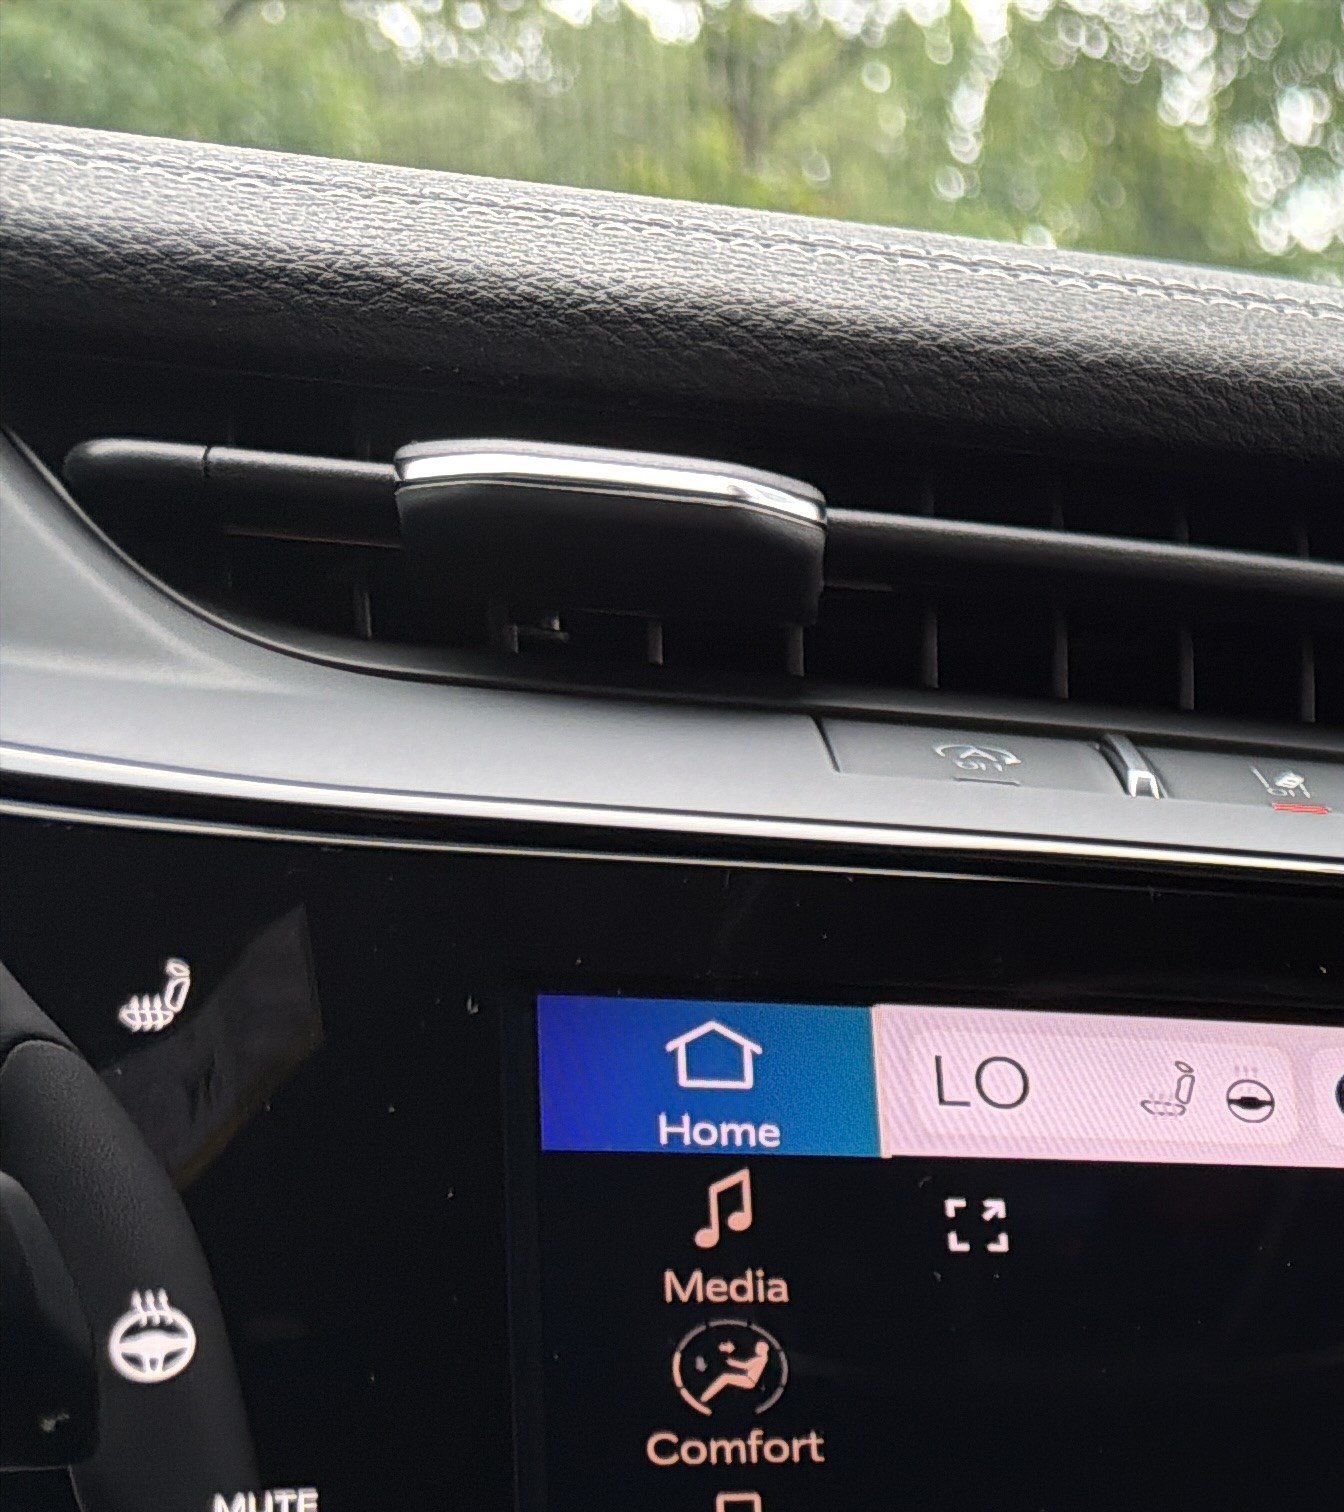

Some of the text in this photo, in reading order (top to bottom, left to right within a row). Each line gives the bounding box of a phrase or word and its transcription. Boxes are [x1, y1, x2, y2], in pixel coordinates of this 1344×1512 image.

[934, 1054, 1030, 1110] LO
[658, 1113, 781, 1148] Home
[664, 1268, 790, 1303] Media
[646, 1429, 825, 1466] Comfort
